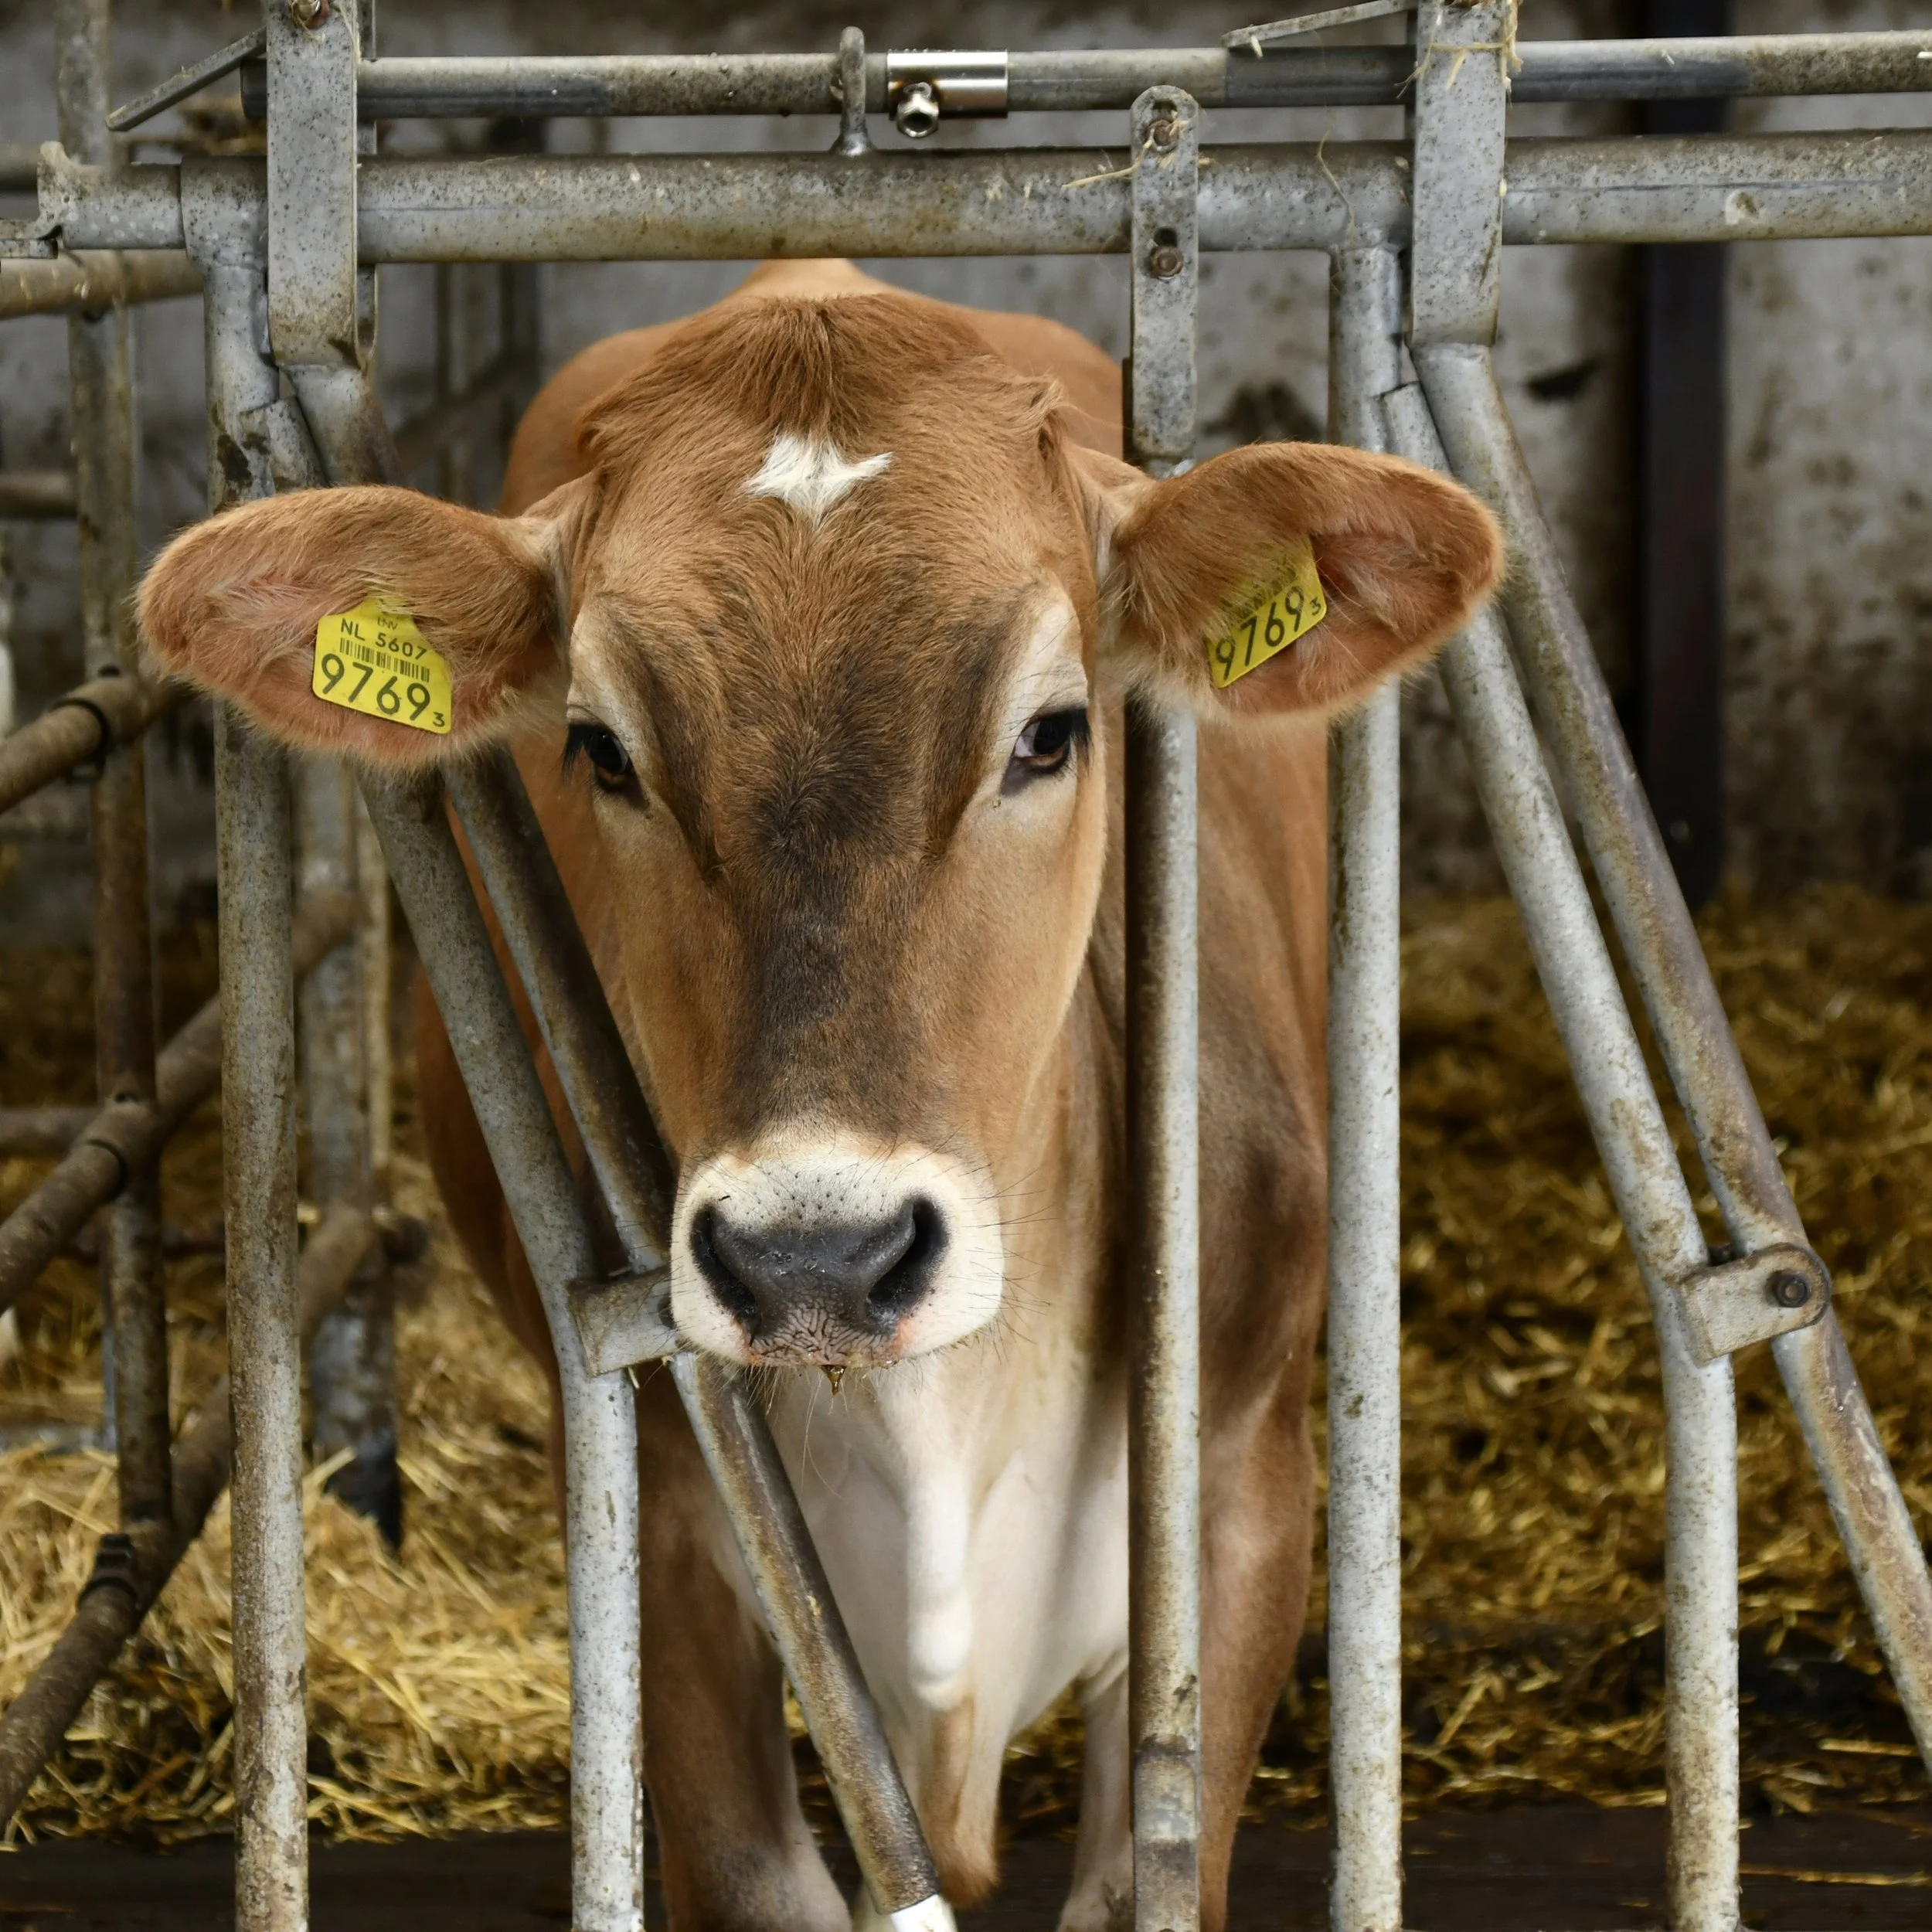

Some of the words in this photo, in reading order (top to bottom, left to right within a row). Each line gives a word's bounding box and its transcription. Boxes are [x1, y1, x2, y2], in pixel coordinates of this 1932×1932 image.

[341, 618, 366, 641] NL
[375, 632, 427, 660] 5607
[1216, 586, 1304, 680] 9769
[321, 653, 430, 721] 9769
[433, 711, 445, 727] 3
